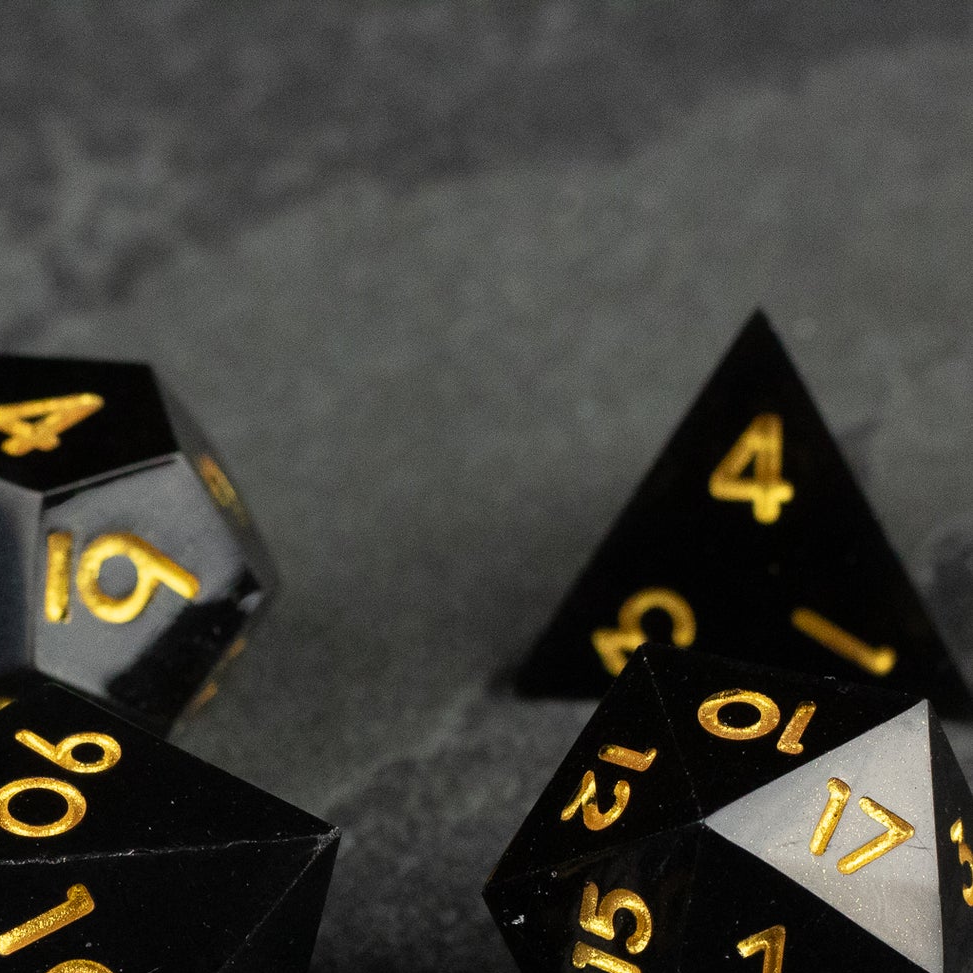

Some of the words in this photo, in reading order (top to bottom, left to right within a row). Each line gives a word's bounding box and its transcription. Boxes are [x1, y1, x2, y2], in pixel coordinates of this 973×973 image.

[709, 413, 795, 525] 4
[792, 607, 897, 677] 1
[696, 688, 818, 756] 10
[560, 743, 658, 832] 12
[809, 777, 916, 876] 17
